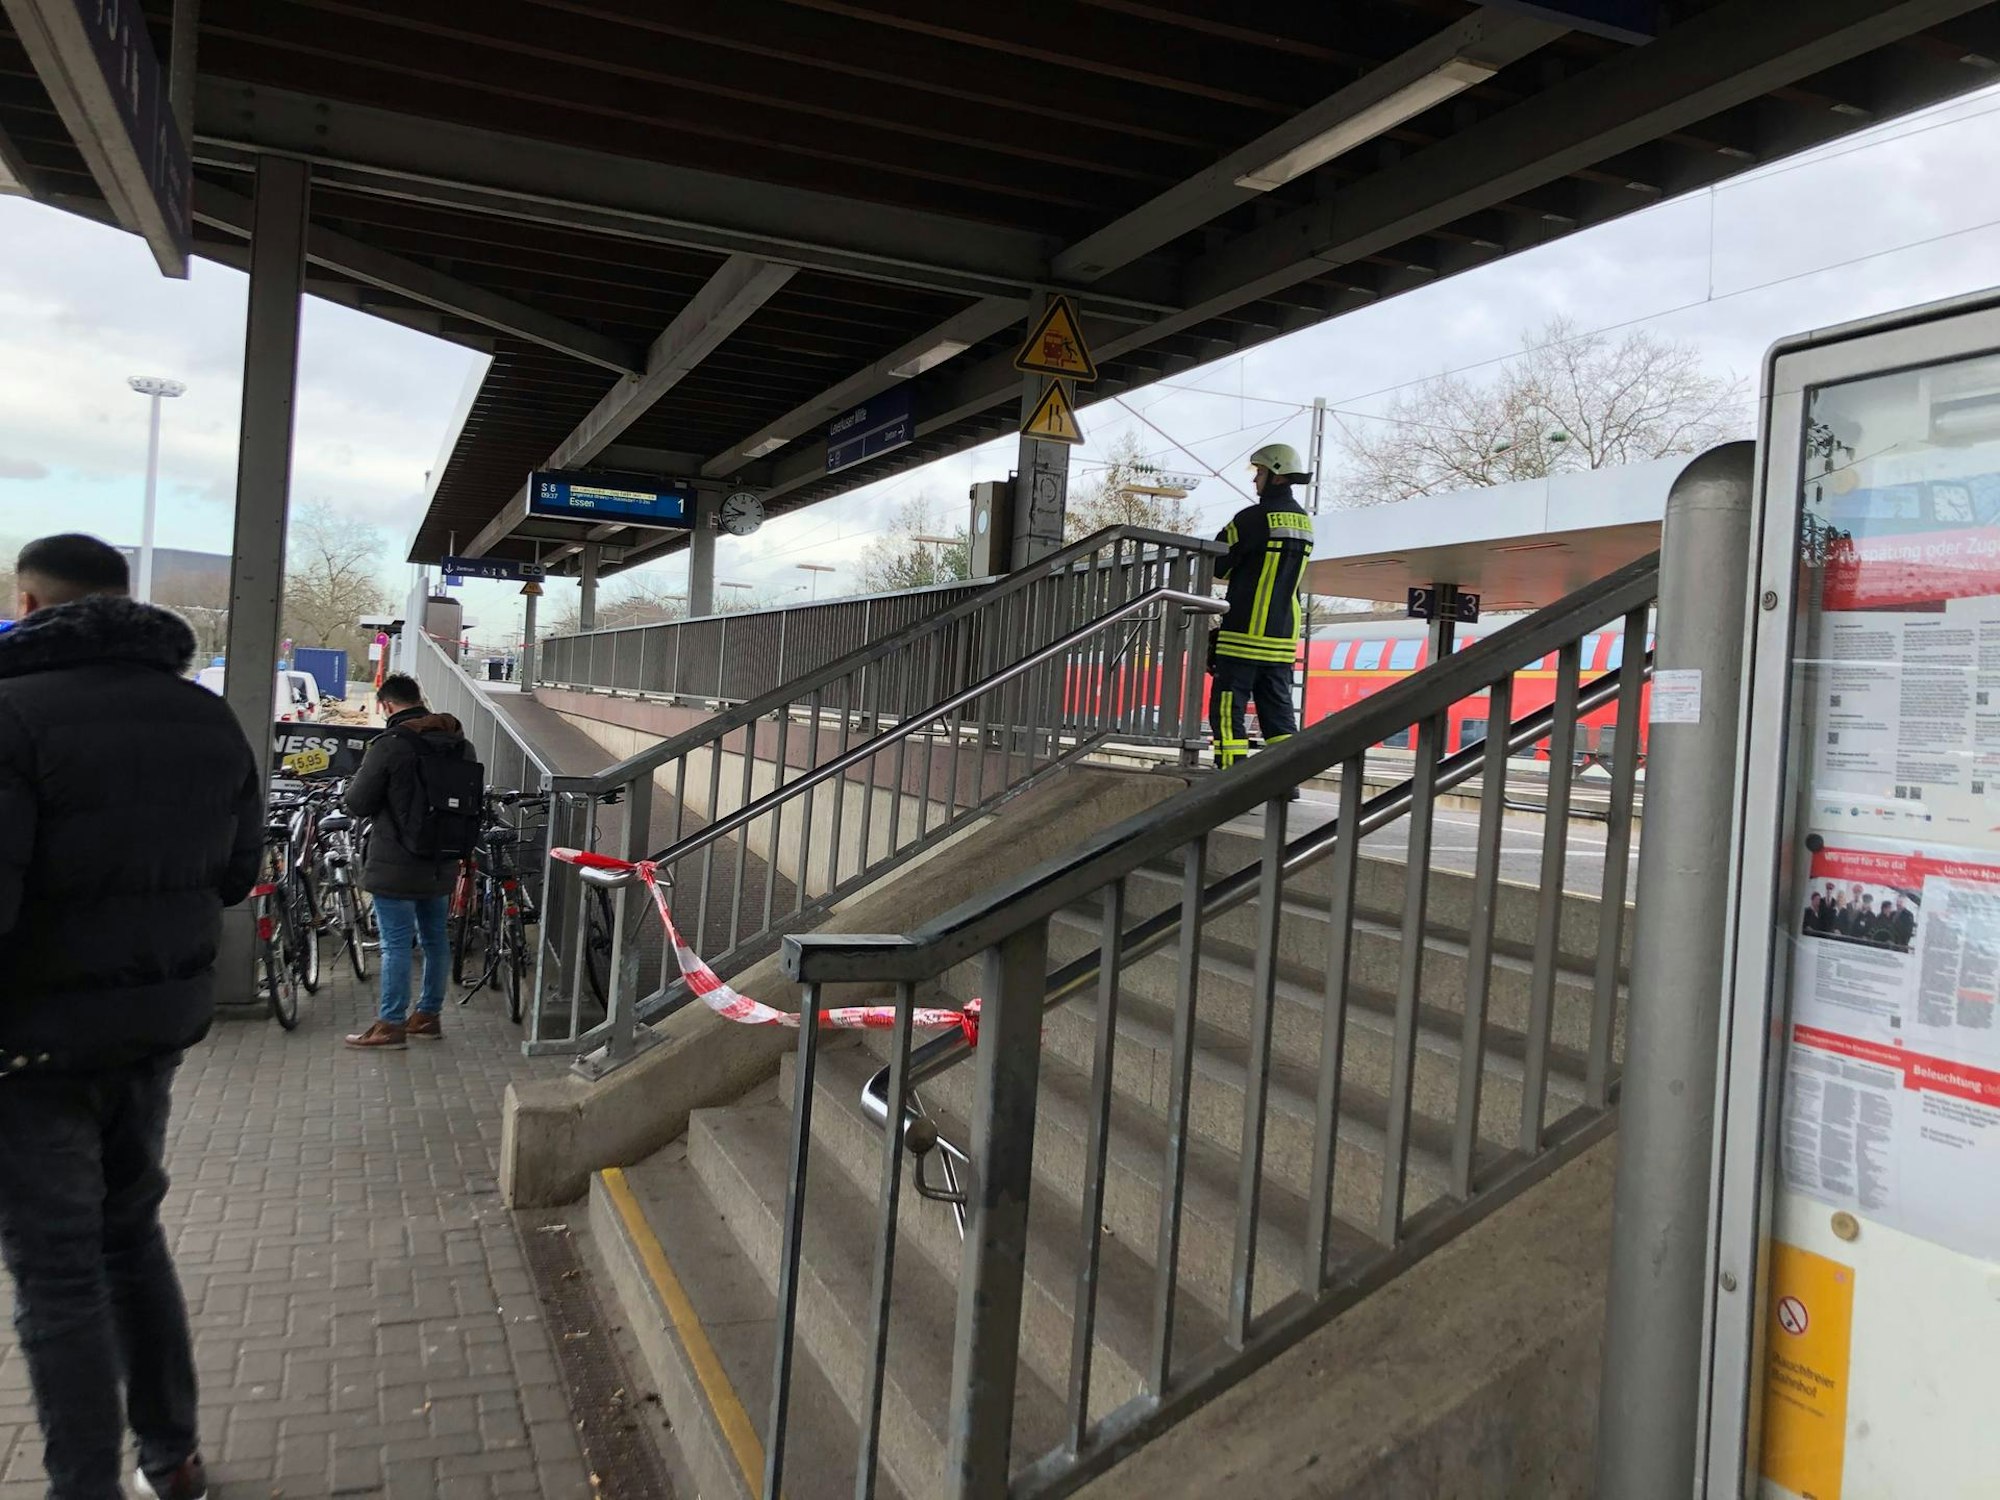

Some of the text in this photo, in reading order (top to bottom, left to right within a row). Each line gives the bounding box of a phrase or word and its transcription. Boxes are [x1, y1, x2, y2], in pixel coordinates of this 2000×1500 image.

[541, 482, 557, 493] S 6
[569, 497, 595, 508] Essen
[677, 498, 685, 514] 1
[1926, 541, 1962, 555] oder
[1967, 536, 2000, 558] Zug
[1413, 589, 1428, 616] 2
[1463, 594, 1477, 616] 3
[1875, 857, 1890, 868] Sie
[1891, 859, 1906, 870] da!
[1913, 1063, 1982, 1094] Beleuchtung
